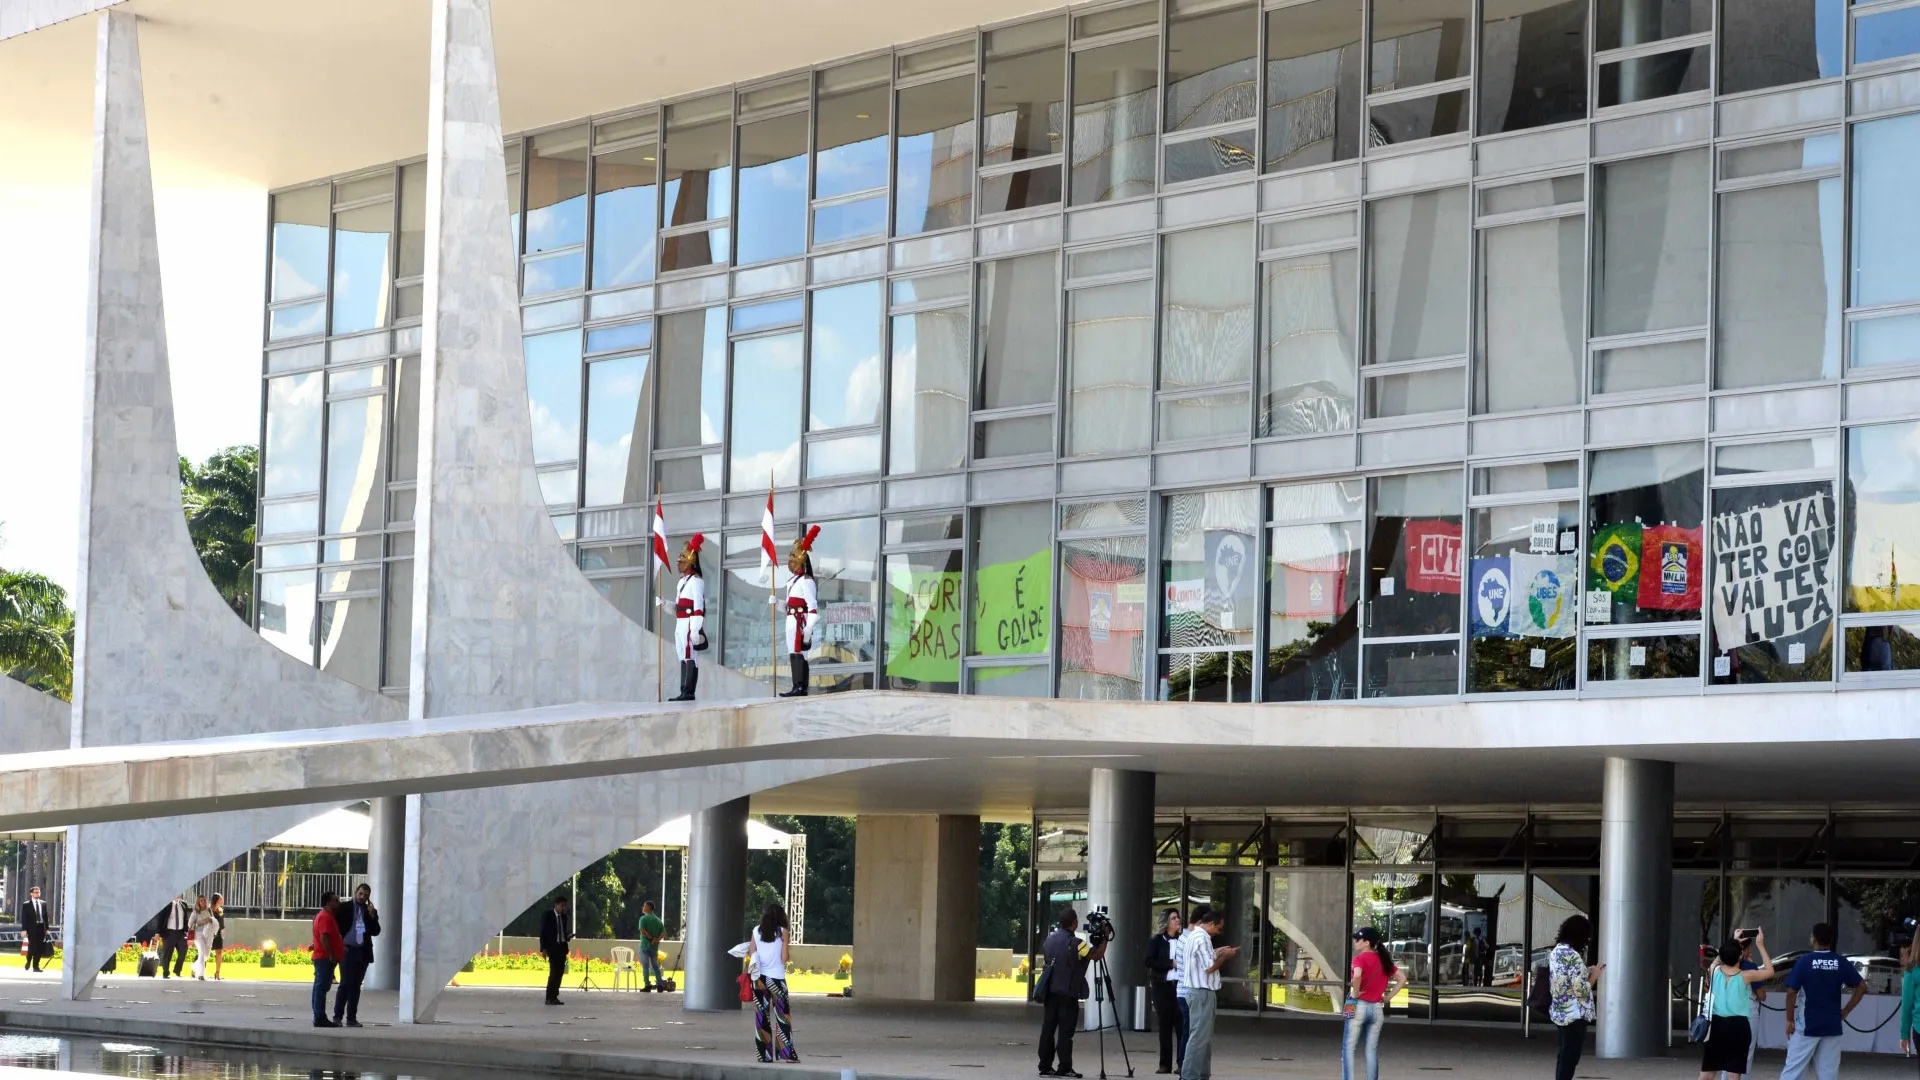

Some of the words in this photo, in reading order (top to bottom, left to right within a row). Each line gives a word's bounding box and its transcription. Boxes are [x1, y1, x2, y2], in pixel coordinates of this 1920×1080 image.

[1421, 535, 1462, 574] CUT
[1720, 545, 1769, 583] TER
[1015, 565, 1026, 609] É
[1488, 587, 1504, 600] UNE
[1536, 586, 1558, 600] UBES
[998, 606, 1044, 651] GOLPE
[1745, 587, 1834, 644] LUTA
